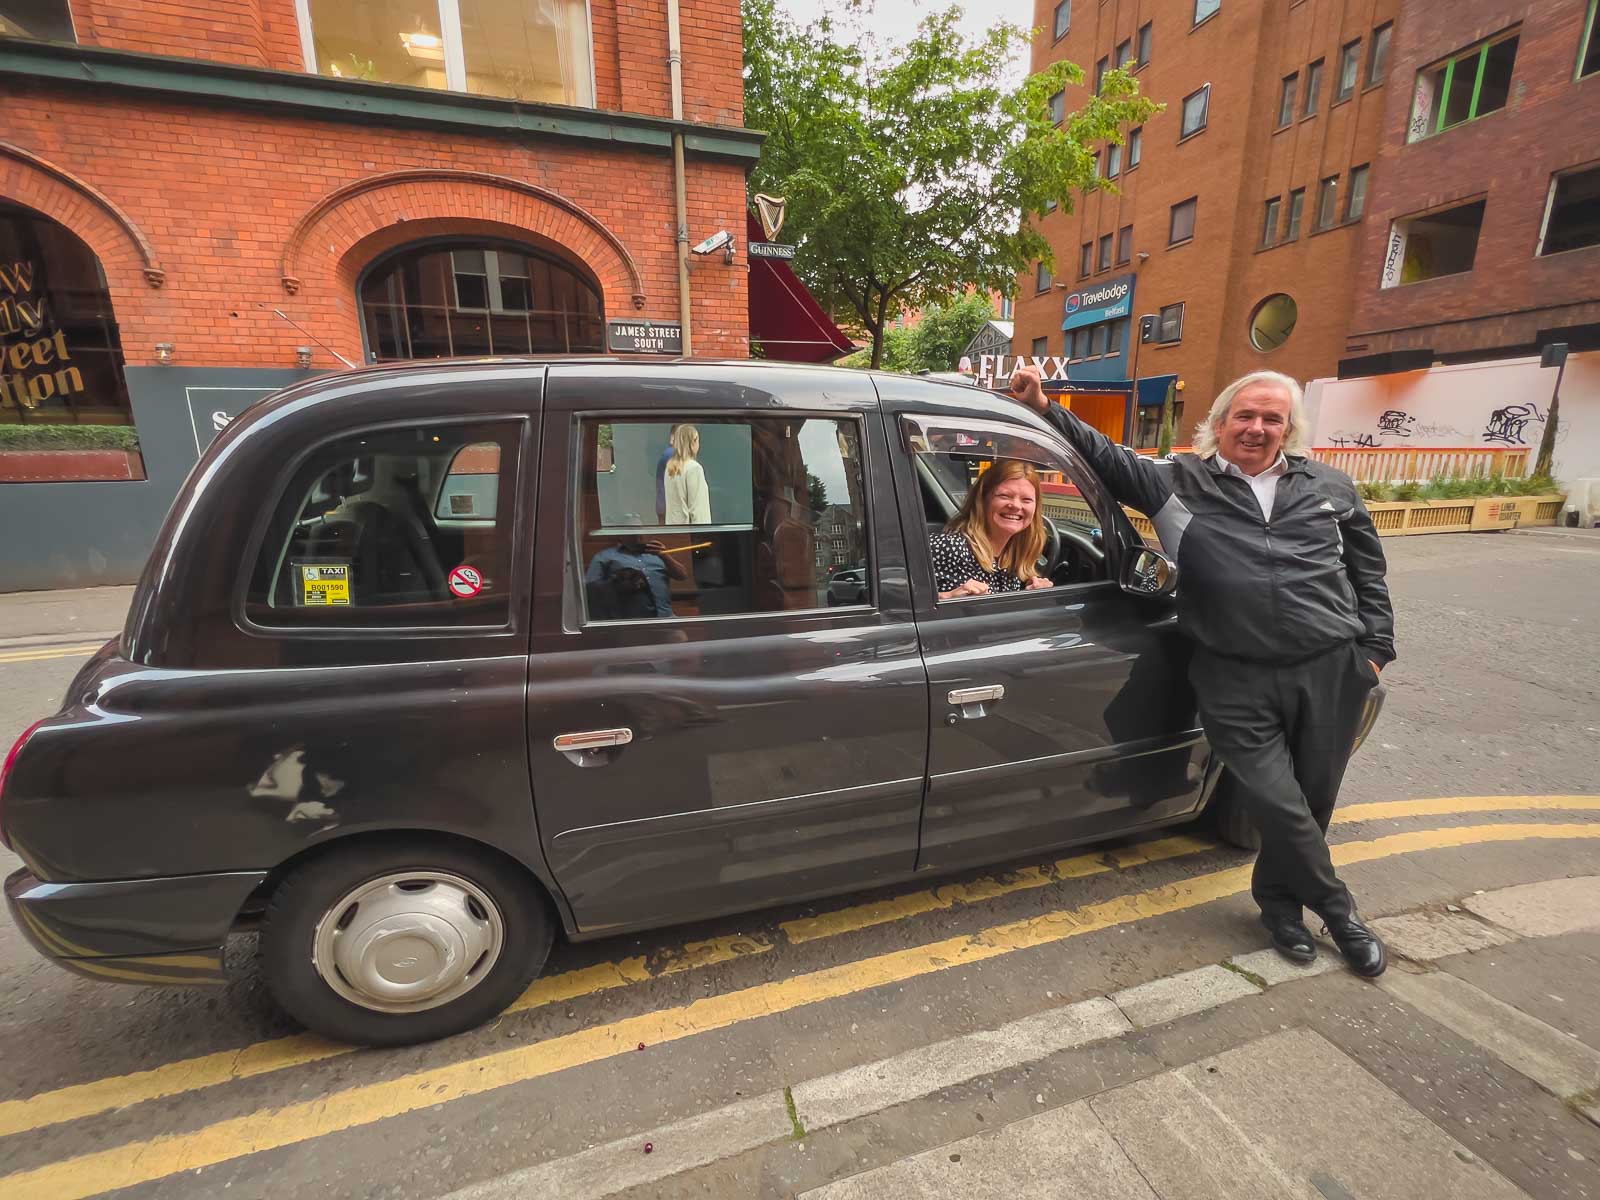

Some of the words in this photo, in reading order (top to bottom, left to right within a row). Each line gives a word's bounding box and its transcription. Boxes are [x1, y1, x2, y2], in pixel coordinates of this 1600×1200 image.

[750, 244, 792, 256] GUINNESS
[1082, 284, 1128, 306] Travelodge
[1104, 306, 1125, 318] Belfast
[615, 326, 645, 337] JAMES
[648, 327, 681, 338] STREET
[634, 338, 664, 349] SOUTH
